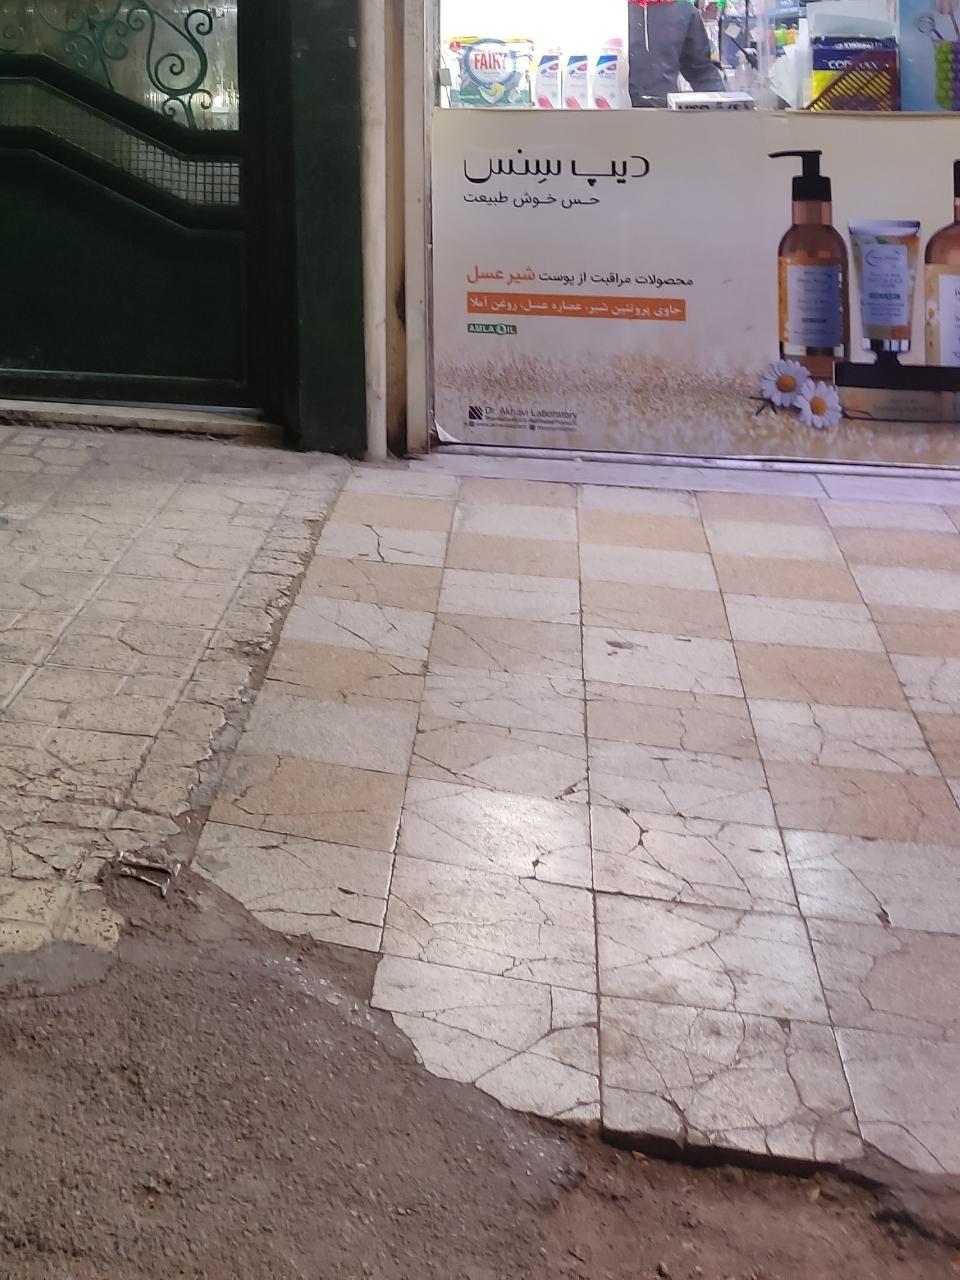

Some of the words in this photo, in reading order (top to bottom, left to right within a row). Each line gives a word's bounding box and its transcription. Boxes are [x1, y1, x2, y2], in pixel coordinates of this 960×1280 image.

[474, 51, 507, 70] FAIRY
[570, 154, 651, 188] دیپ
[462, 191, 509, 207] طبیعت
[512, 191, 558, 208] خوش
[560, 194, 601, 209] حس
[466, 264, 504, 284] عسل
[506, 265, 536, 286] شیر
[538, 271, 576, 287] پوست
[577, 271, 587, 287] از
[590, 273, 632, 288] مراقبت
[635, 273, 694, 288] محصولات
[490, 297, 518, 312] روغن
[551, 299, 582, 313] عصاره
[653, 304, 682, 317] حاوی
[469, 324, 495, 333] AMLA
